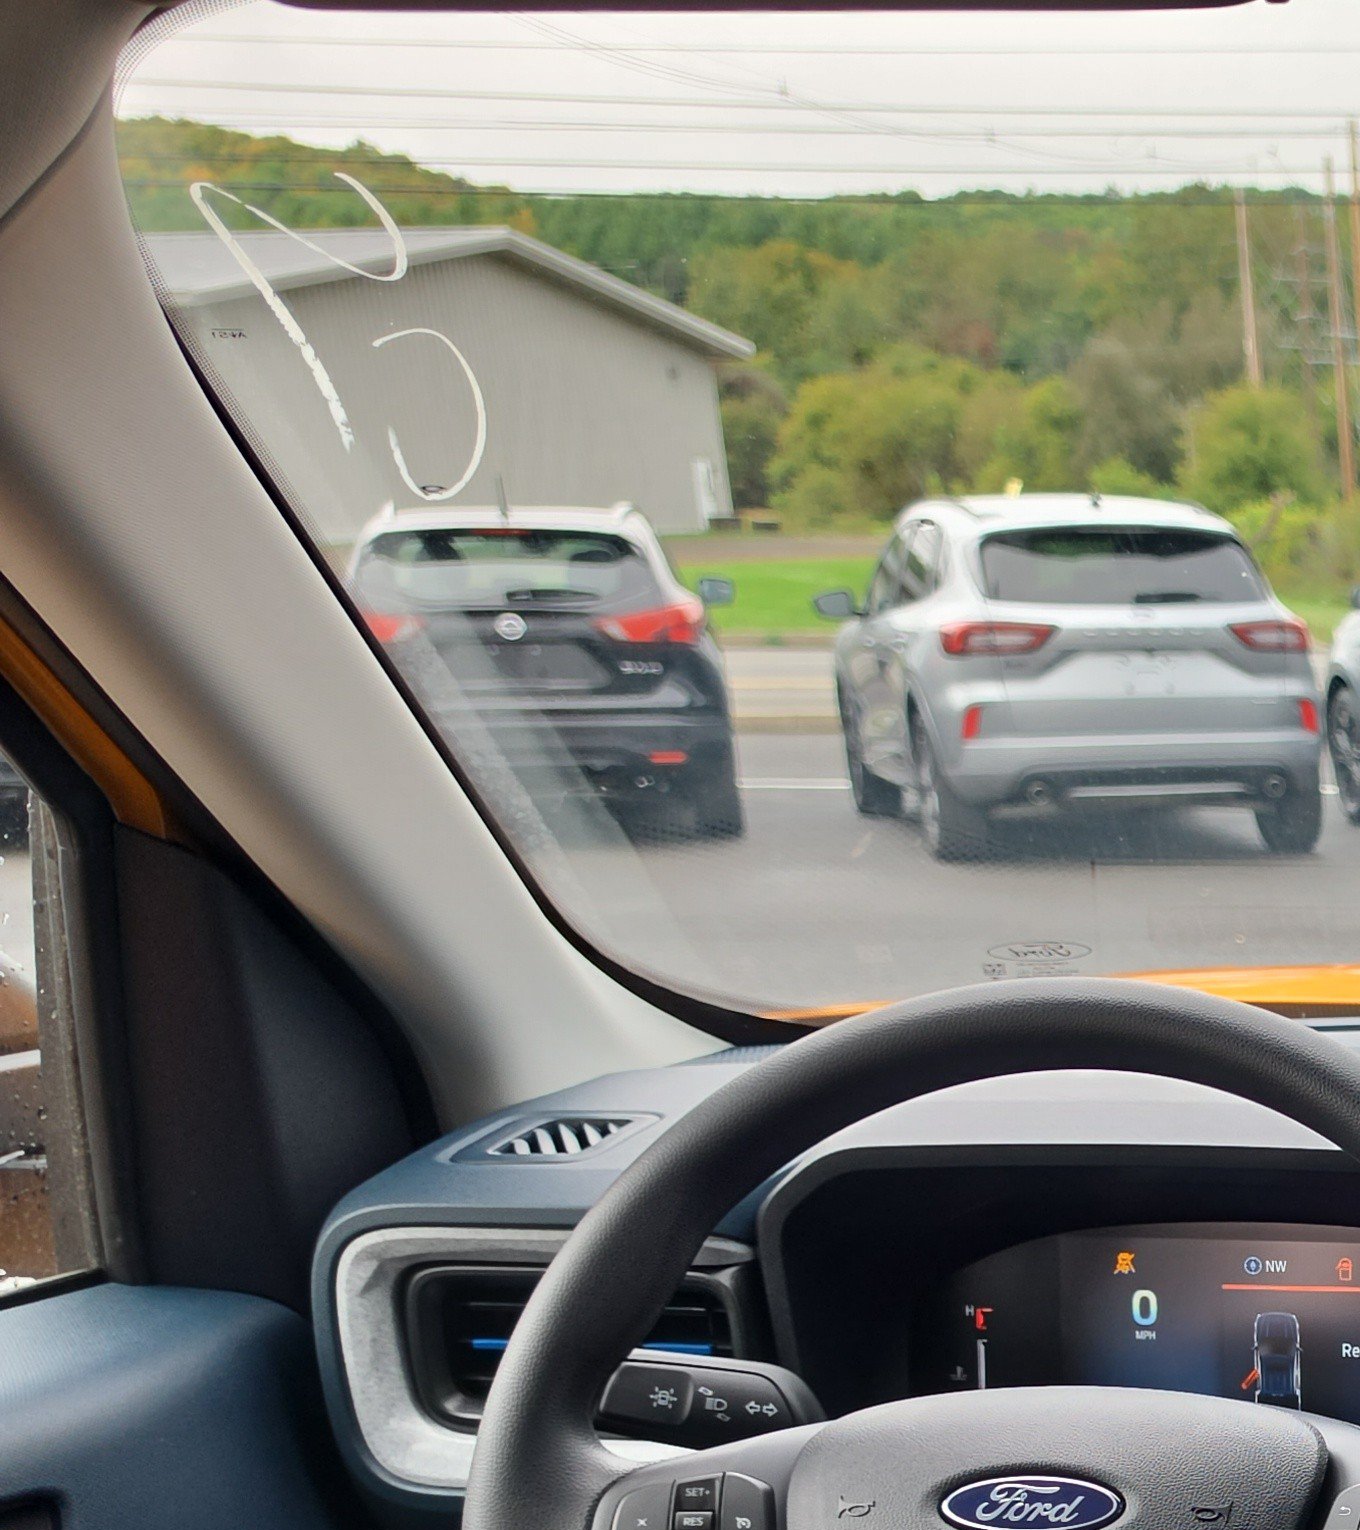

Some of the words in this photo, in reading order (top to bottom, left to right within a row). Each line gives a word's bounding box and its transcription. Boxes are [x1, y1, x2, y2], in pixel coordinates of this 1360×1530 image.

[1266, 1260, 1287, 1273] NW
[1131, 1289, 1158, 1326] 0
[1135, 1330, 1156, 1341] MPH
[685, 1487, 710, 1498] SET+
[976, 1483, 1080, 1525] Ford
[683, 1517, 703, 1527] RES
